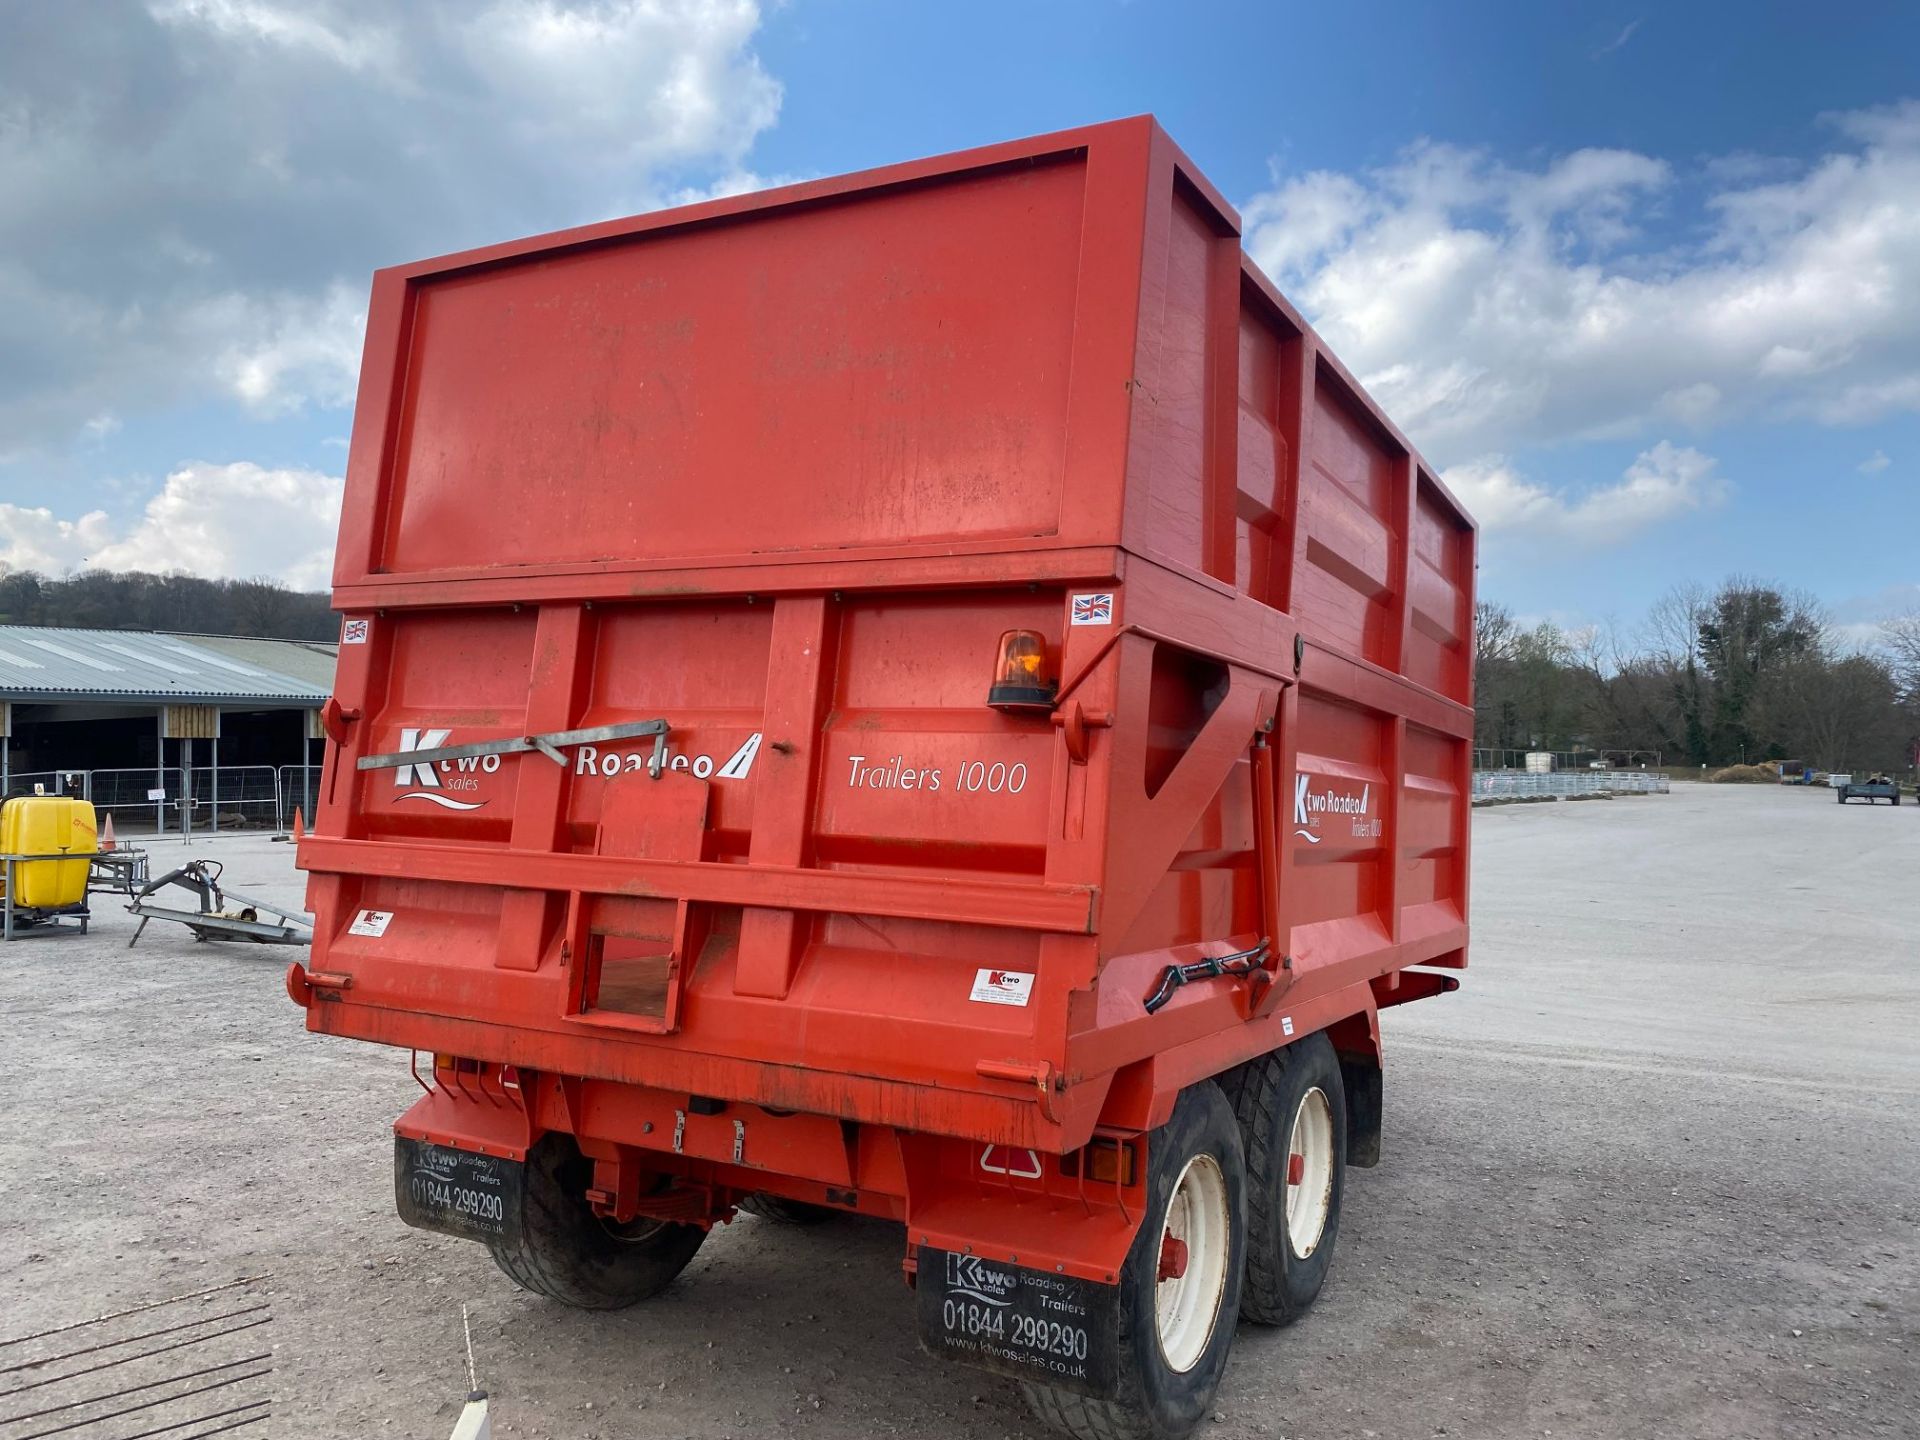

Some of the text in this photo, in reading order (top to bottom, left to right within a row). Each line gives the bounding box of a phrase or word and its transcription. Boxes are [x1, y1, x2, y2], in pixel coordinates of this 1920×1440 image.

[447, 774, 479, 791] sales
[848, 755, 942, 791] Trailers
[956, 761, 1028, 793] 1000
[1294, 773, 1360, 824] Ktwo Roadeo
[988, 971, 1021, 986] Ktwo
[472, 1171, 502, 1187] Trailers
[412, 1177, 503, 1221] 01844 299290
[947, 1251, 1065, 1292] Ktwo Roadeo
[982, 1284, 1006, 1296] sales
[1040, 1294, 1086, 1316] Trailers
[943, 1299, 1088, 1360] 01844 299290
[944, 1335, 1087, 1379] wwwktwosales.co.uk
